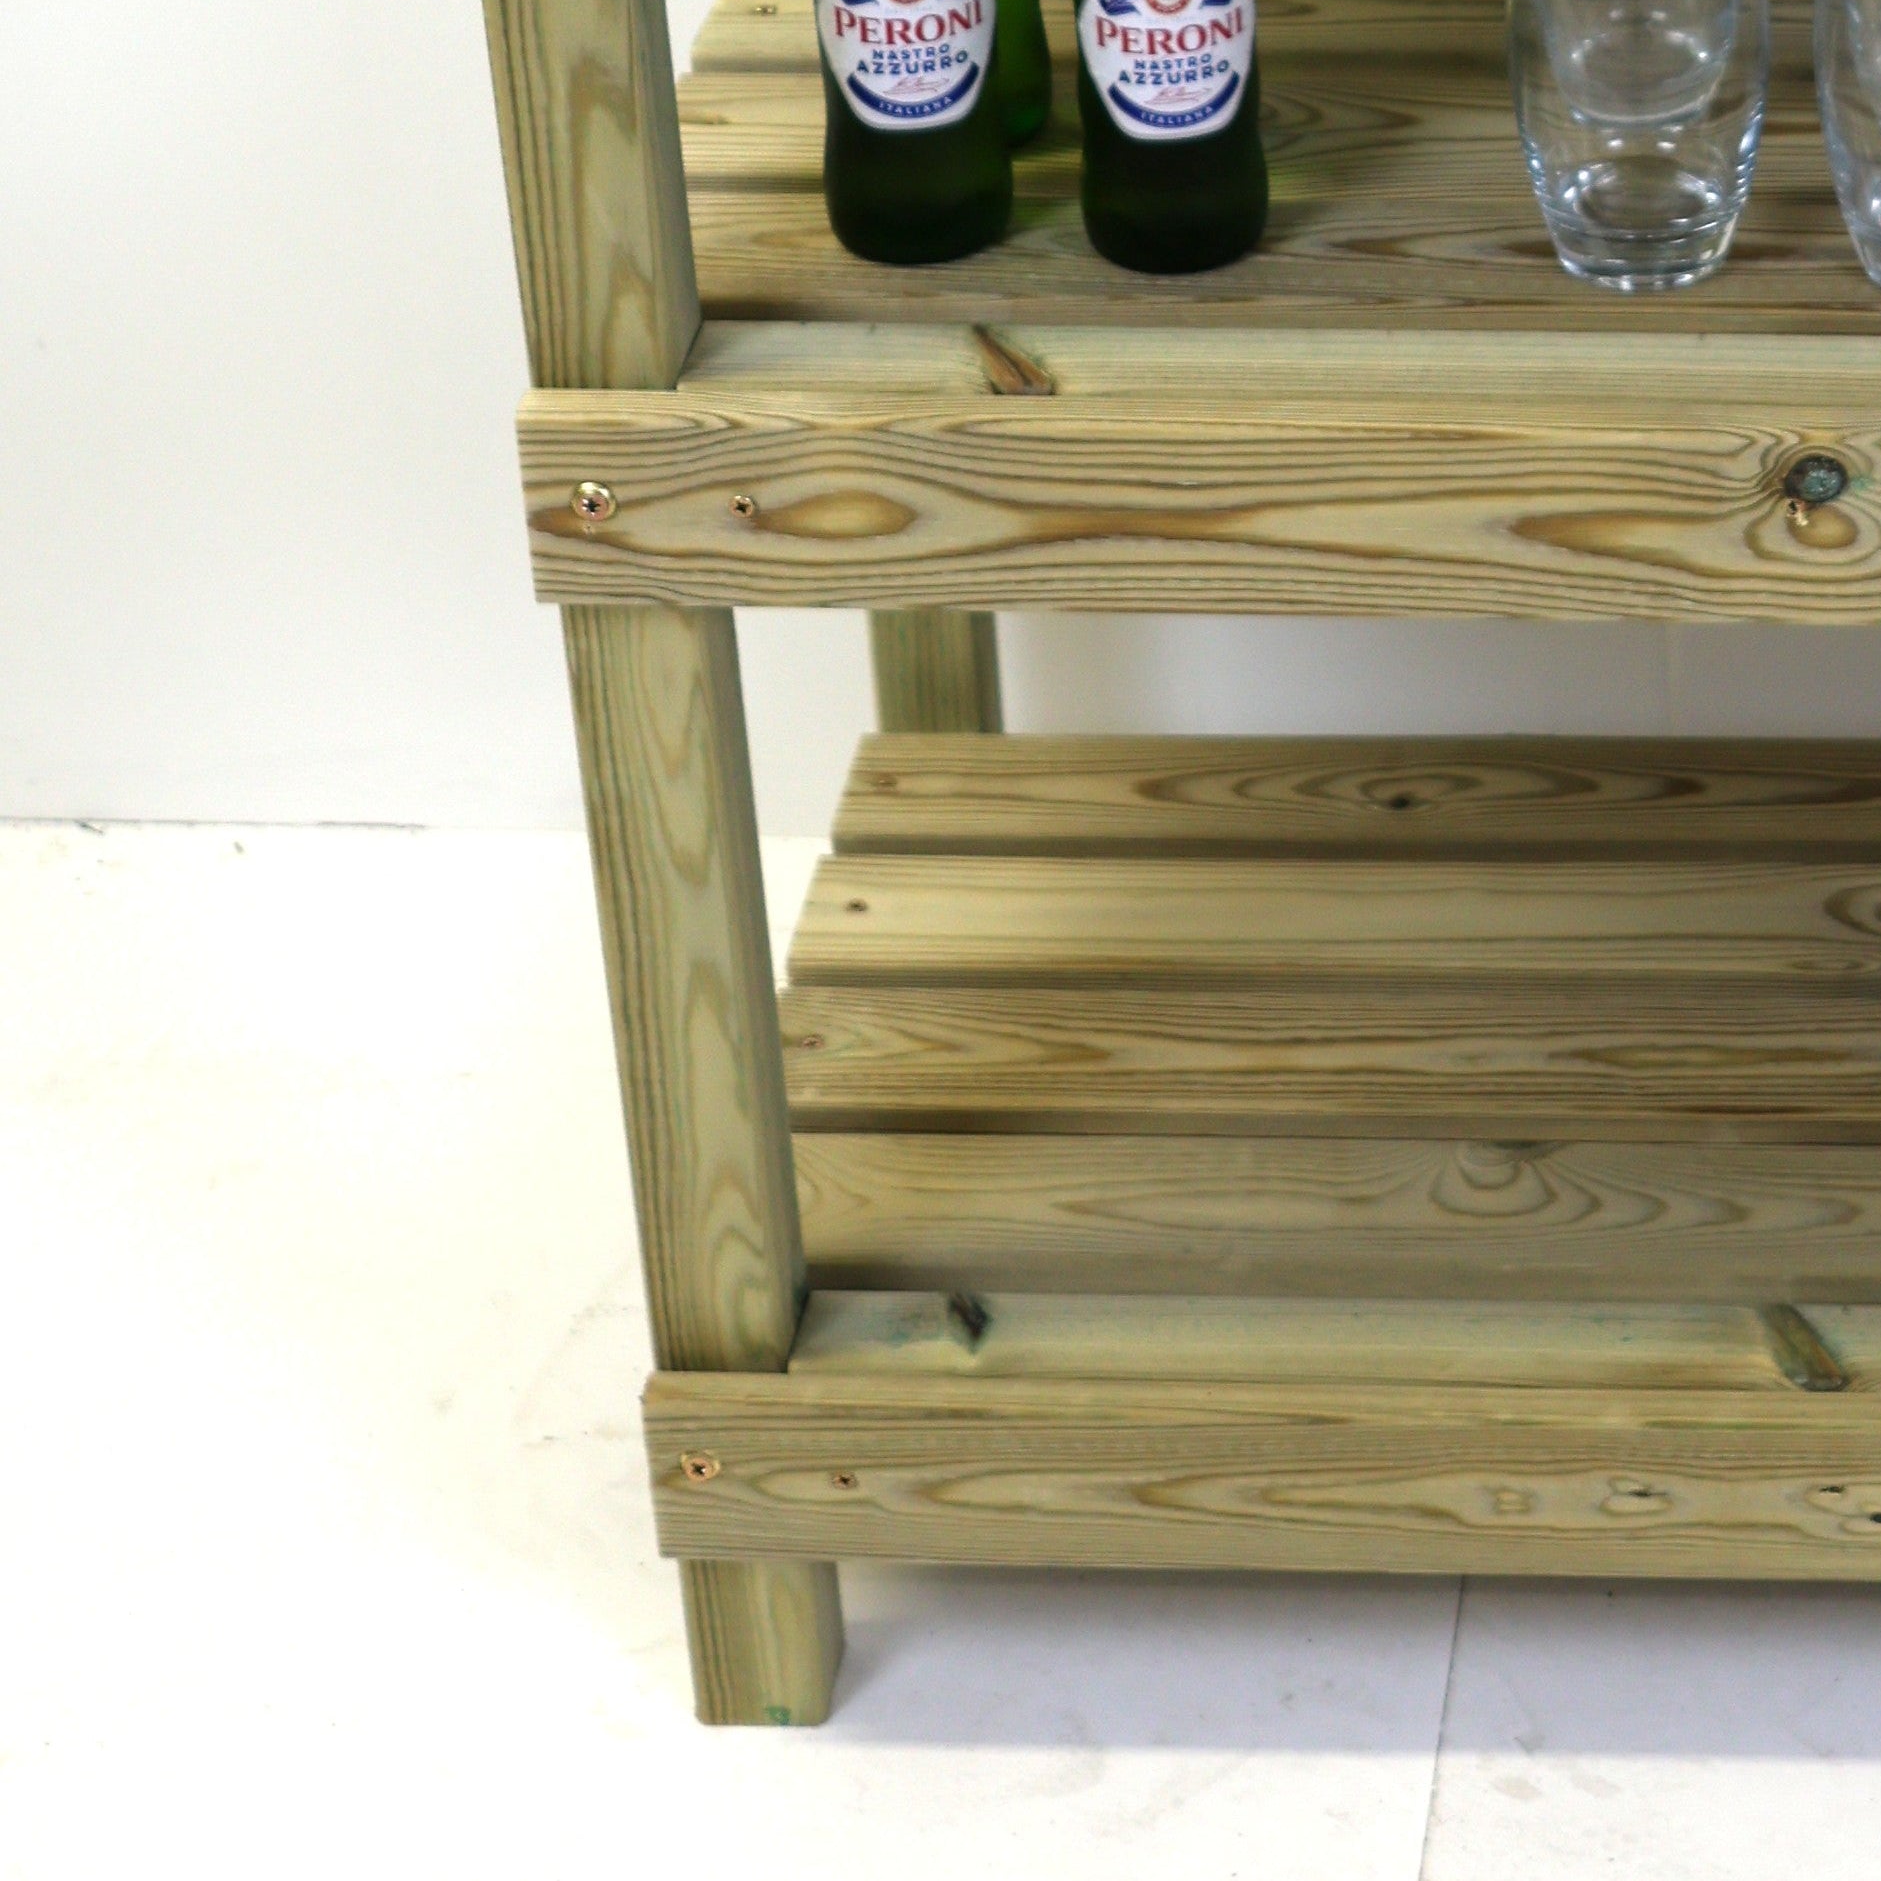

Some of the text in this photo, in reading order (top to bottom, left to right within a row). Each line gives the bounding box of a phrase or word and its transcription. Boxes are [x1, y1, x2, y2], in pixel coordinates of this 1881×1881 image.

[1095, 5, 1243, 55] PERONI
[872, 43, 950, 60] NASTRO
[856, 50, 969, 75] AZZURRO
[1134, 53, 1212, 70] NASTRO
[1119, 59, 1230, 85] AZZURRO
[878, 96, 953, 115] ITALIANA
[1140, 105, 1214, 124] ITALIANA
